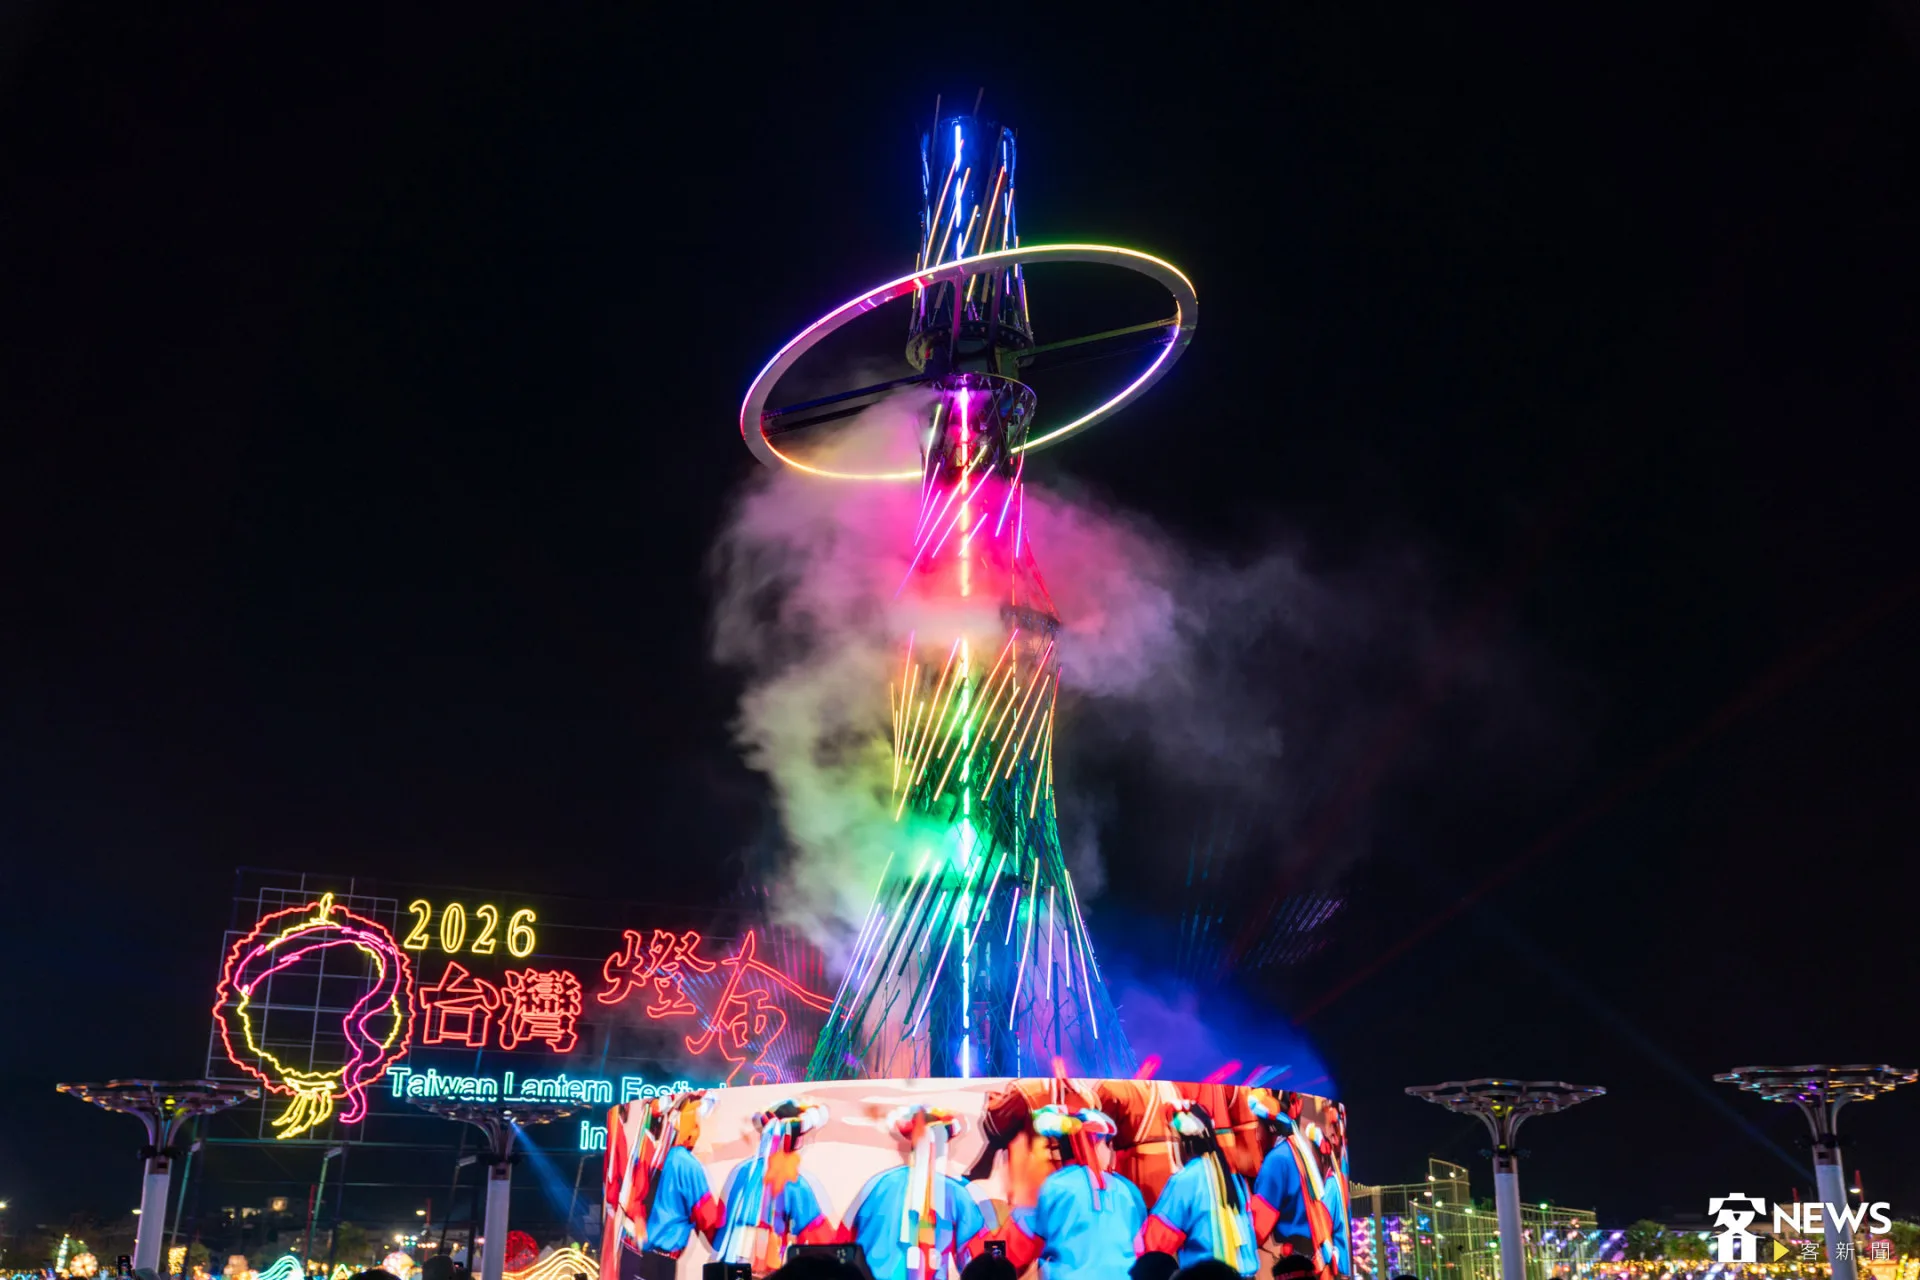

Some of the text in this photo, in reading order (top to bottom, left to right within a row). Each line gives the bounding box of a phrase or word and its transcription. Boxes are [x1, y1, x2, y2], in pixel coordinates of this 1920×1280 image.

[403, 899, 537, 958] 2026
[386, 1066, 498, 1102] Taiwan
[503, 1071, 613, 1103] Lantern
[580, 1120, 608, 1150] in
